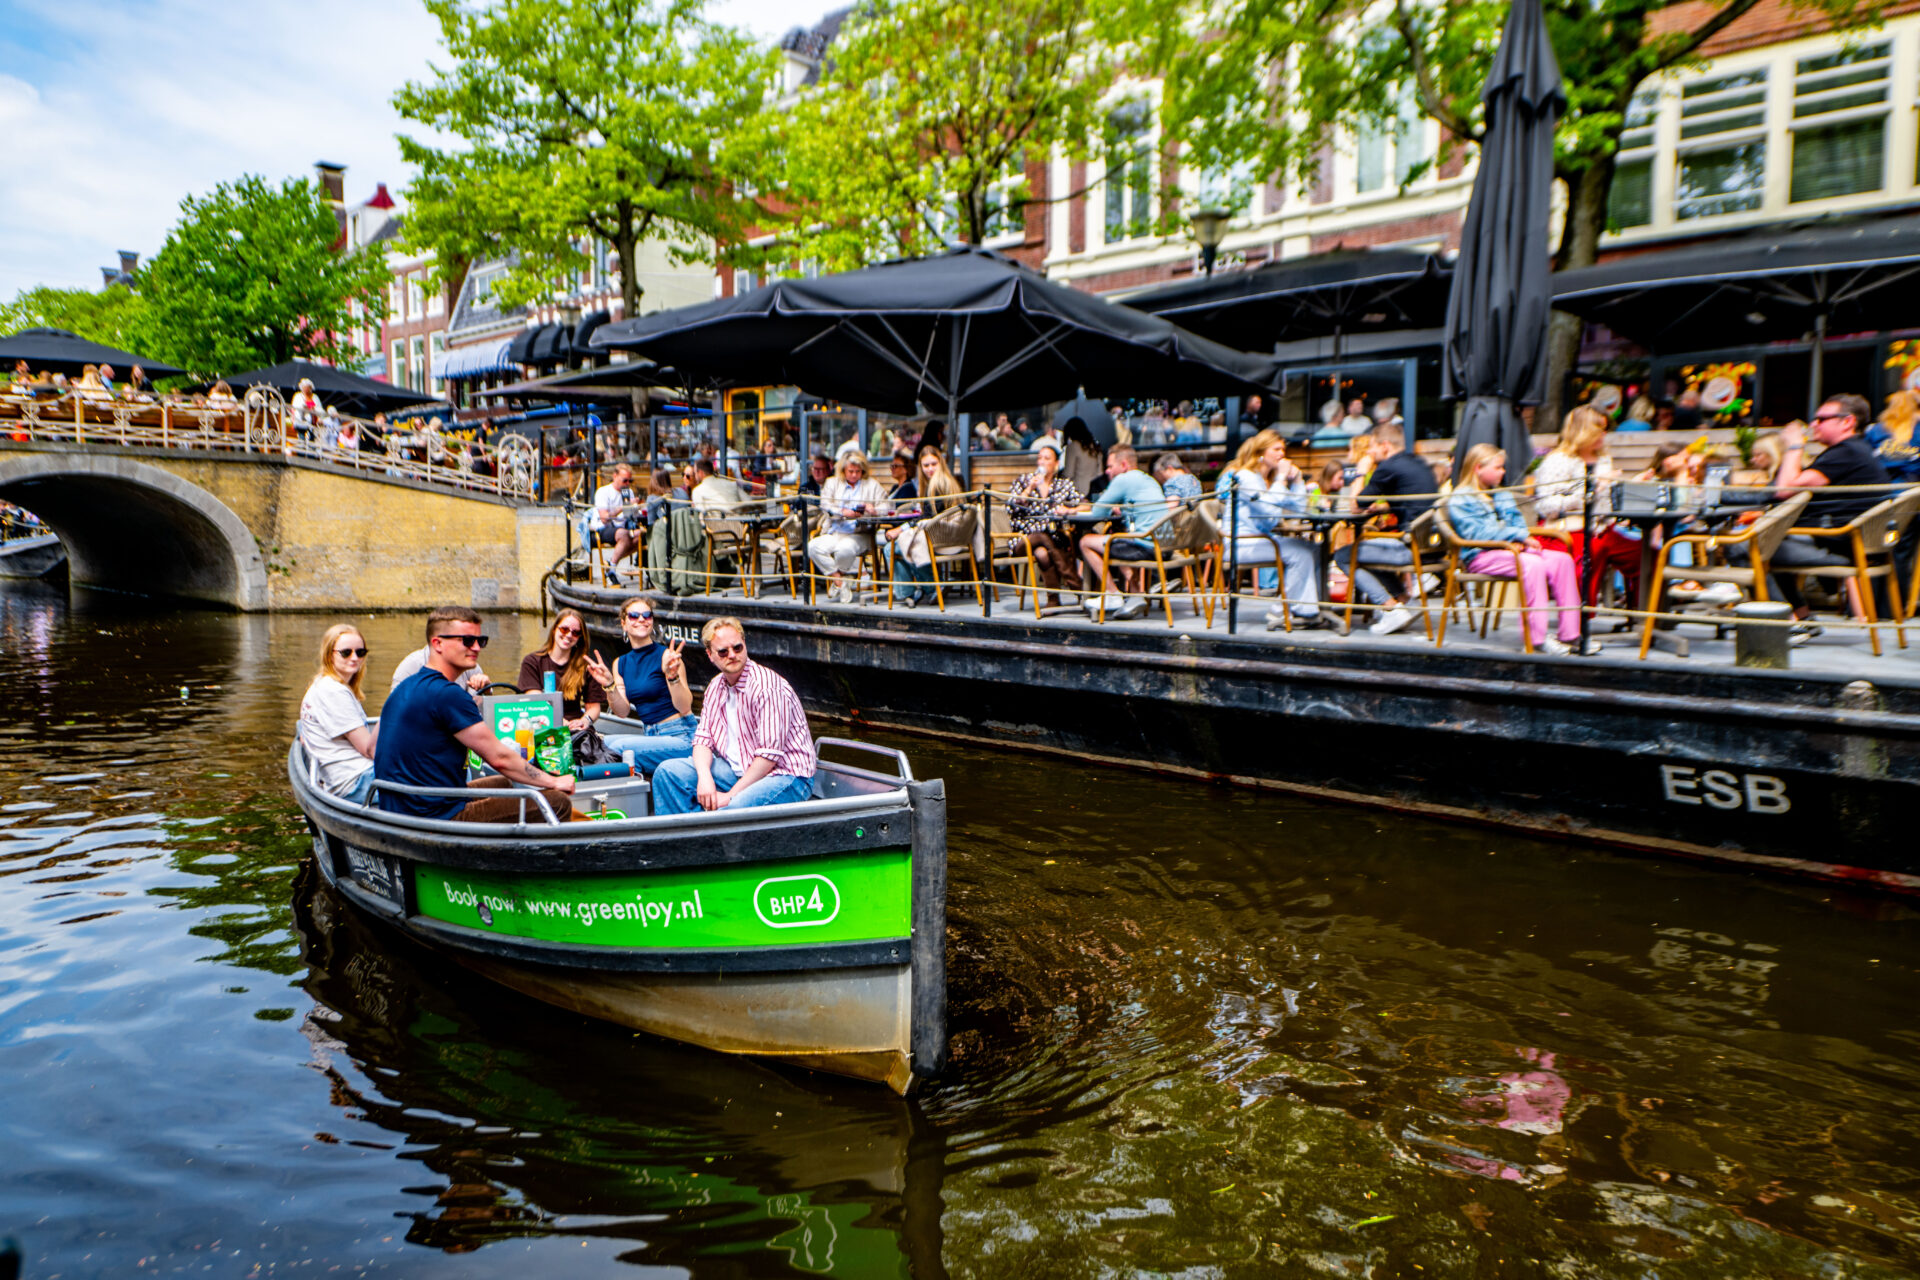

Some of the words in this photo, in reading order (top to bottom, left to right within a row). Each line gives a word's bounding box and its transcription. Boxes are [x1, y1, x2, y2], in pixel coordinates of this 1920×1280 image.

[665, 624, 699, 643] JELLE
[1660, 764, 1791, 814] ESB
[443, 881, 478, 907] Book
[525, 889, 703, 928] www.greenjoy.nl
